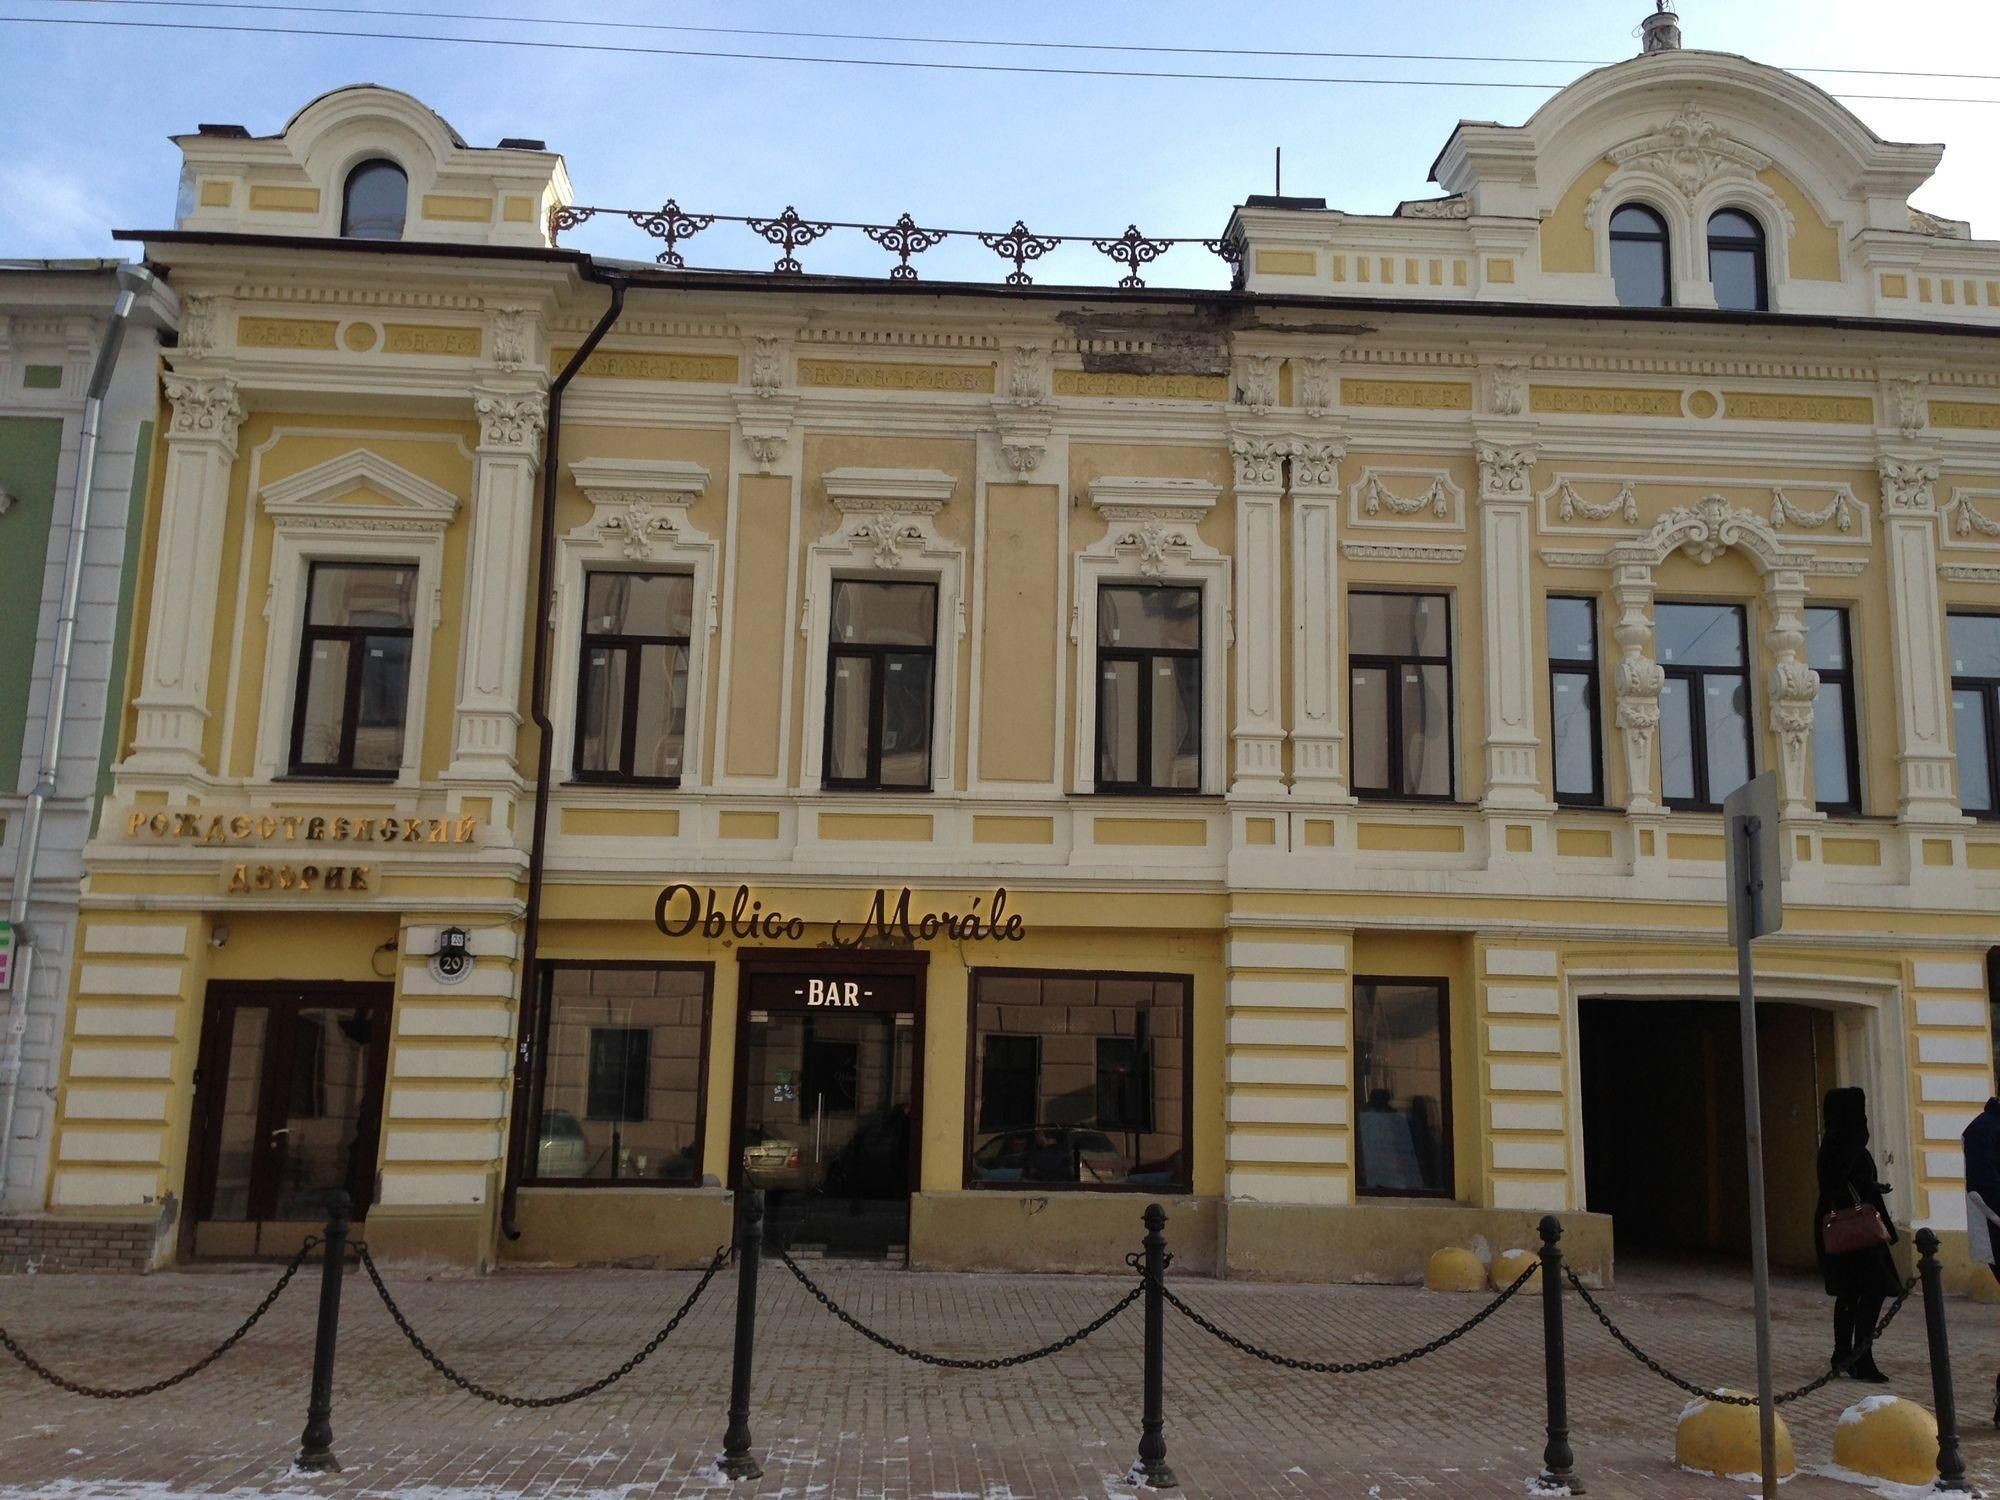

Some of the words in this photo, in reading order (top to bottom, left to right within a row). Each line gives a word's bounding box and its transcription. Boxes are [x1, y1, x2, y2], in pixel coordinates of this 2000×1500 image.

[228, 863, 369, 894] ДВОРИК
[654, 883, 805, 939] Oblico
[831, 886, 1026, 947] Morále
[443, 956, 461, 970] 20
